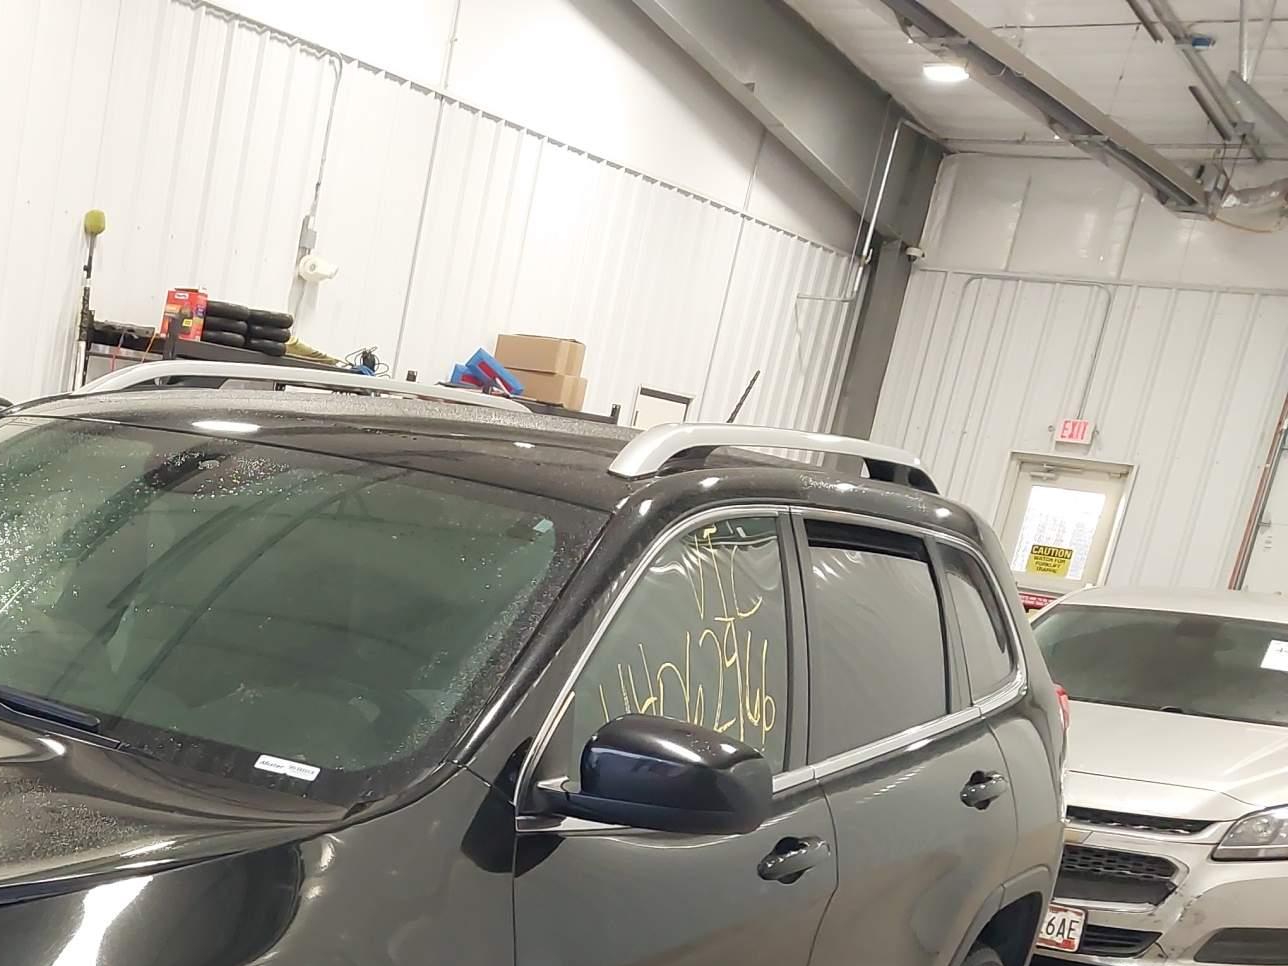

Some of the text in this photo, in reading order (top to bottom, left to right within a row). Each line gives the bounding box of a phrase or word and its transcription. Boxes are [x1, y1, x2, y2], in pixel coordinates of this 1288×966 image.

[1060, 420, 1089, 440] EXIT
[1031, 545, 1073, 559] CAUTION
[1033, 555, 1054, 564] WATCH
[1035, 560, 1062, 569] FORKLIFT
[1036, 566, 1057, 574] TRAFFIC
[1040, 915, 1081, 941] 6AE
